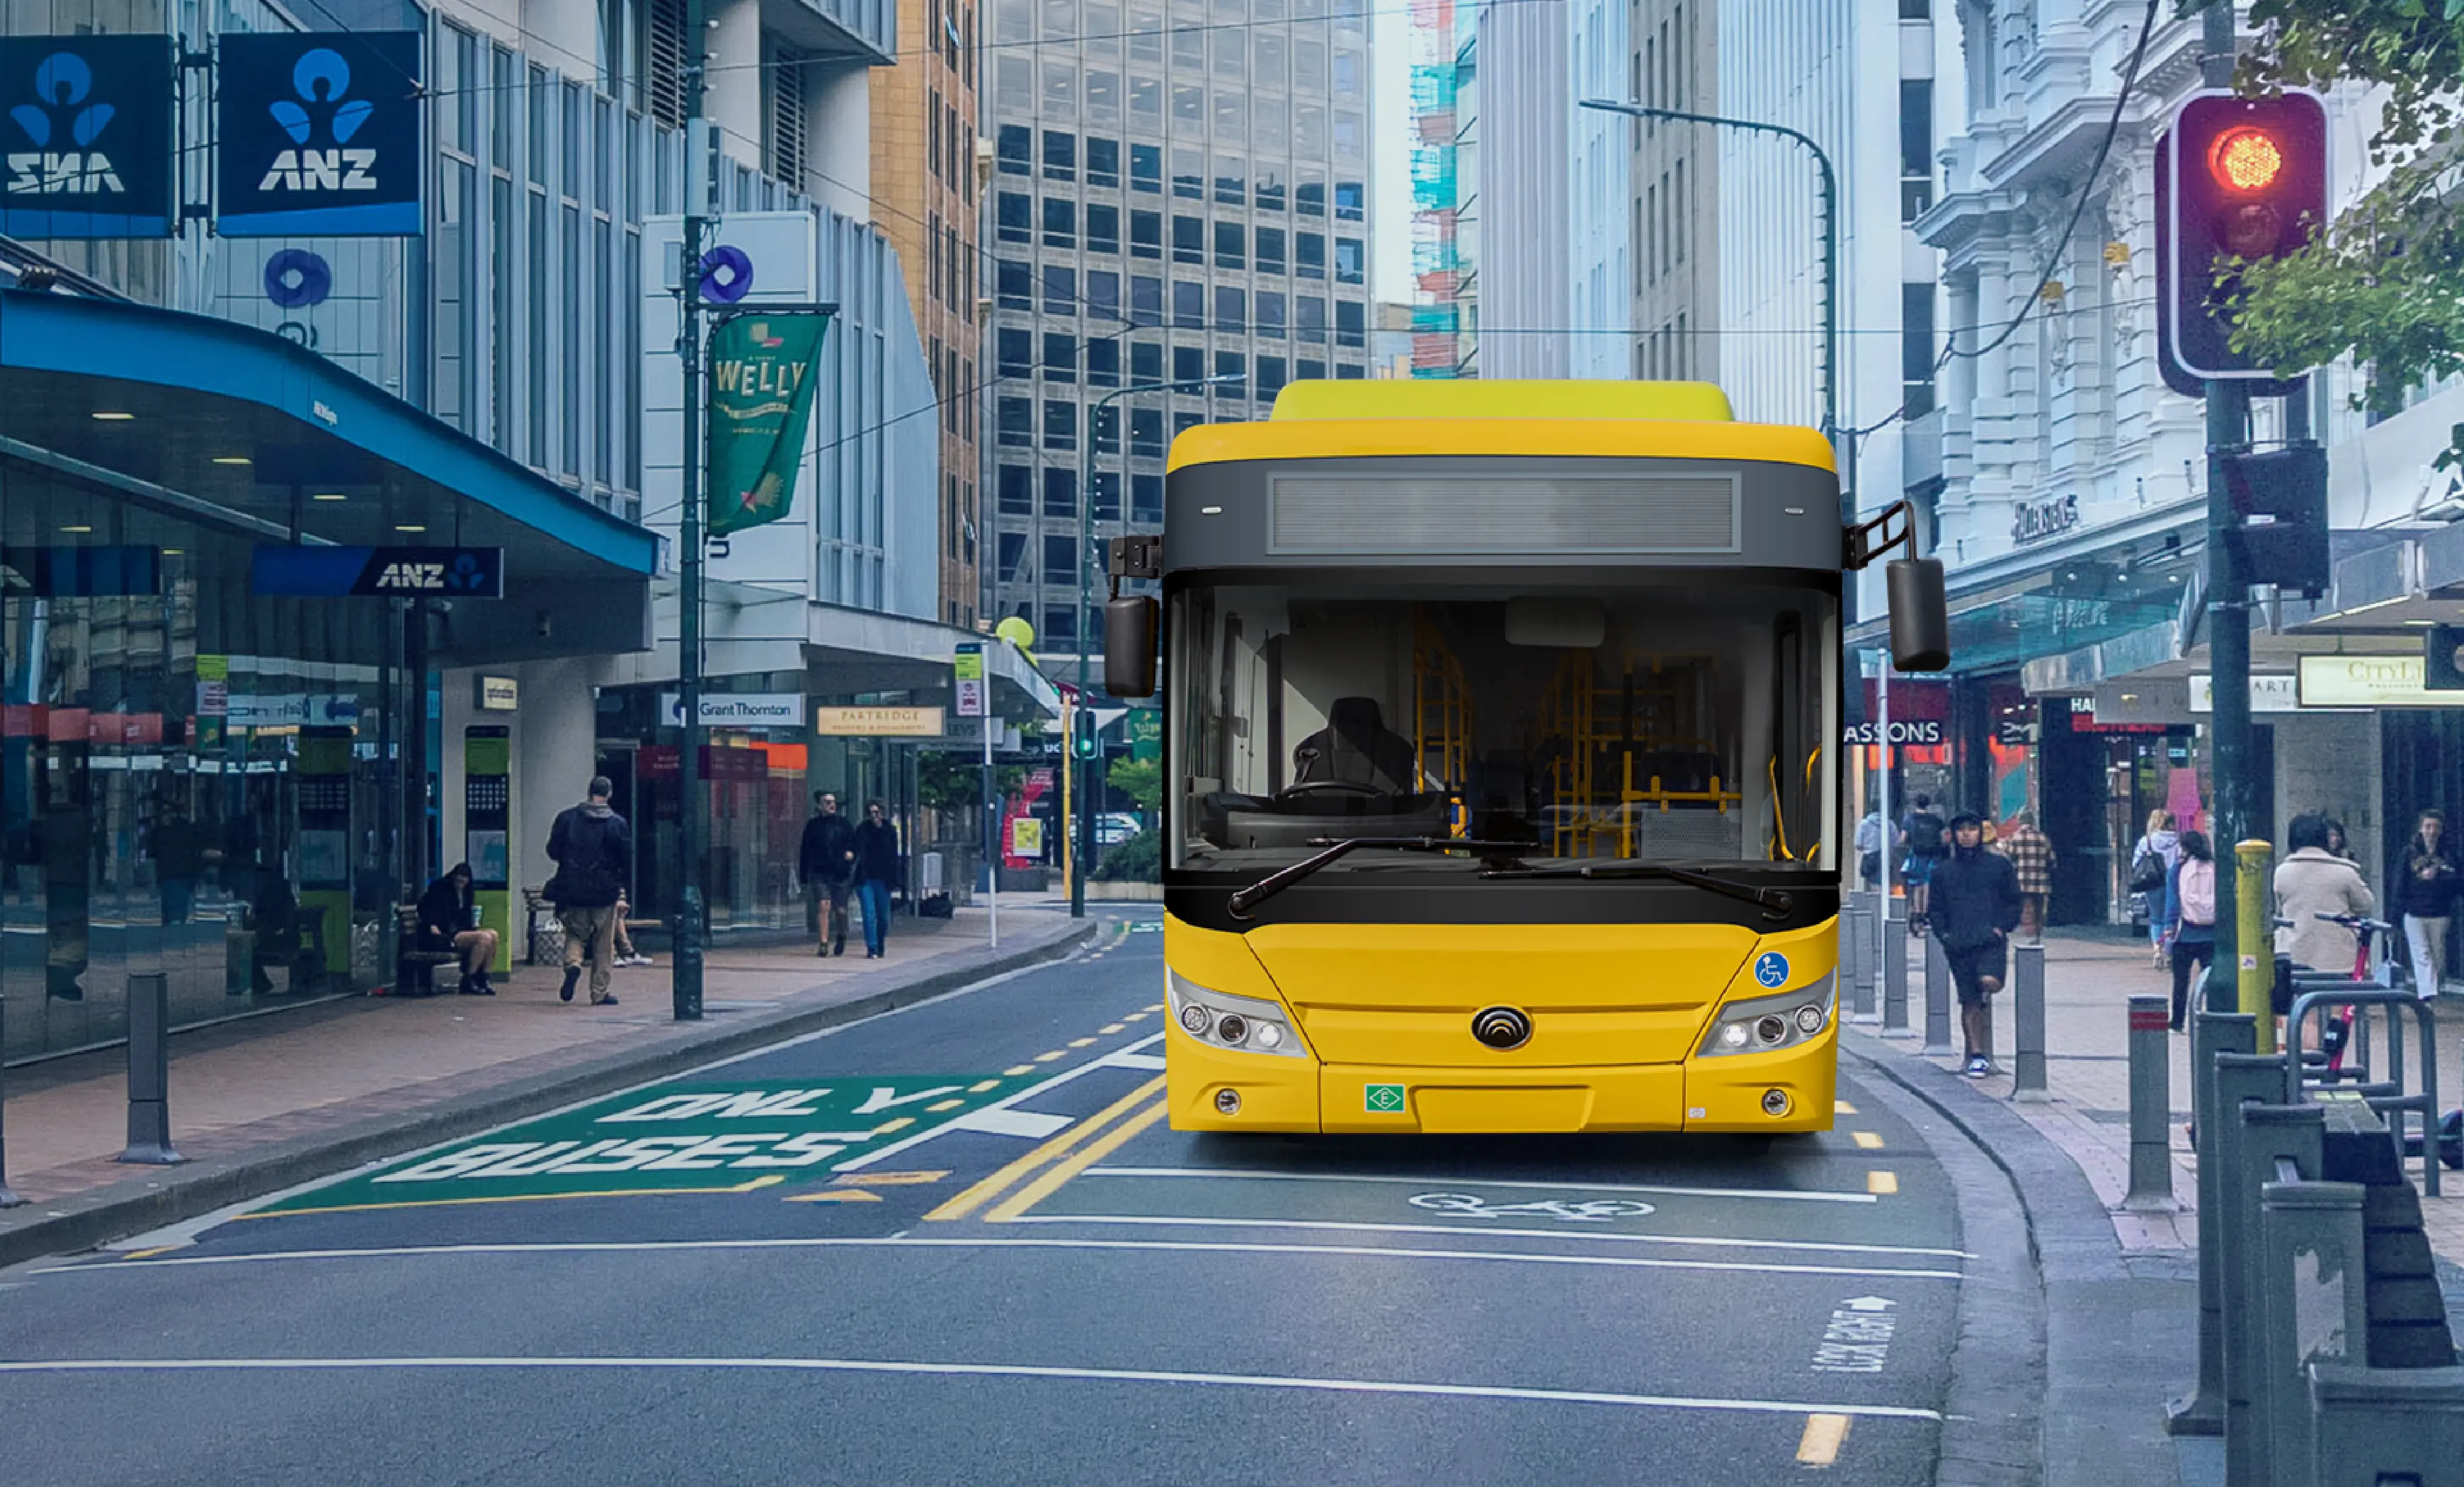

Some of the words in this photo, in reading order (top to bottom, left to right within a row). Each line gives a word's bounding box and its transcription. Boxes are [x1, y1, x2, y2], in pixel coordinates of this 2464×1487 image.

[258, 149, 377, 190] ANZ
[715, 360, 806, 397] WELLY
[376, 563, 445, 588] ANZ
[735, 702, 791, 716] Thornton
[841, 711, 919, 721] PARTRIDGE
[593, 1086, 964, 1123] ONLY
[370, 1132, 878, 1183] BUSES
